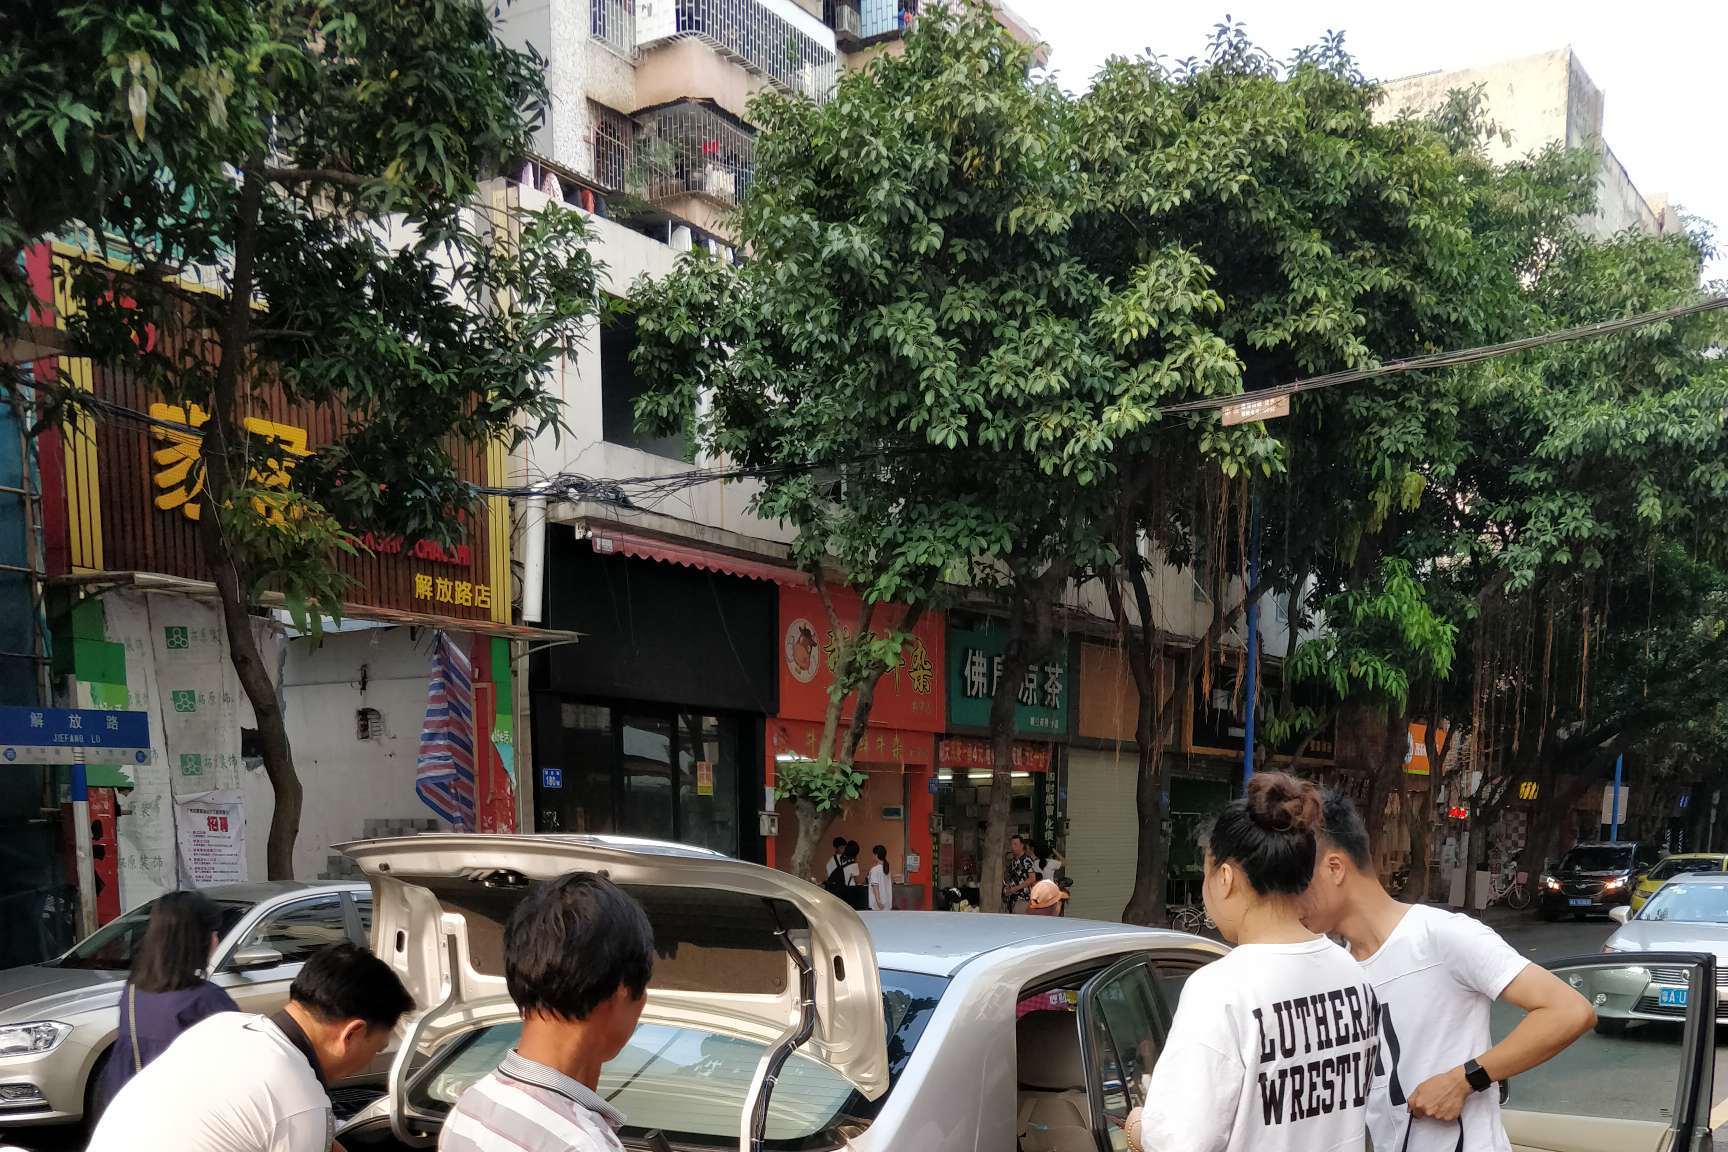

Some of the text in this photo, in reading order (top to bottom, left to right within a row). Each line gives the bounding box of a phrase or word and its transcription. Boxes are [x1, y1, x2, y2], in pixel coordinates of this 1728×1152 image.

[415, 573, 491, 609] 解放路店
[30, 711, 119, 731] 解放路
